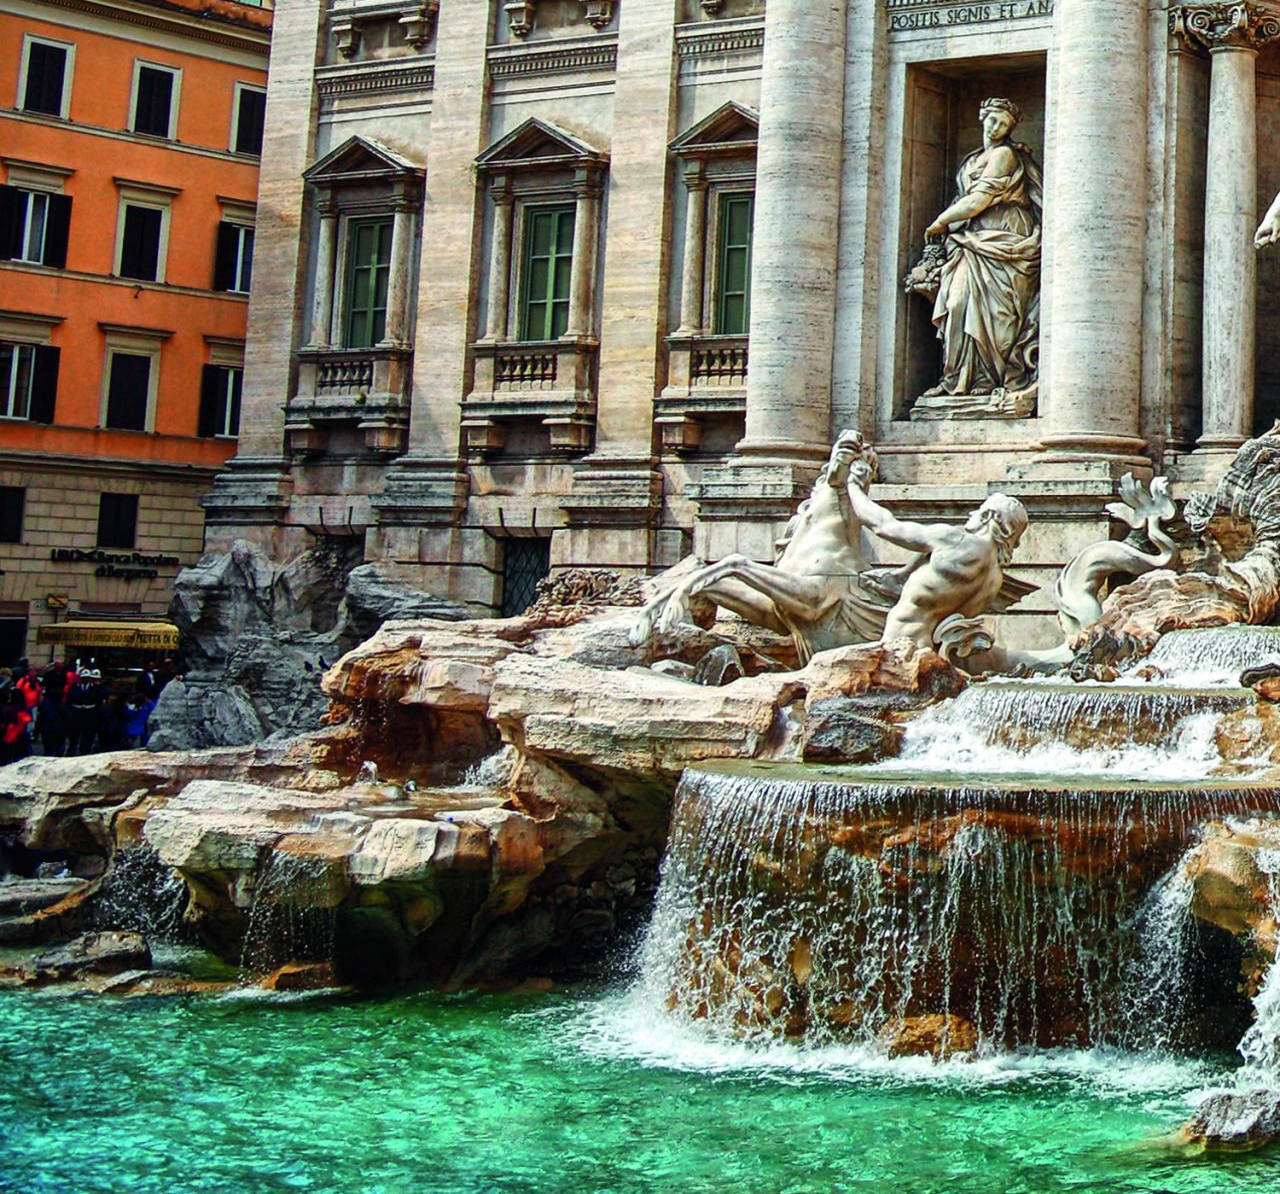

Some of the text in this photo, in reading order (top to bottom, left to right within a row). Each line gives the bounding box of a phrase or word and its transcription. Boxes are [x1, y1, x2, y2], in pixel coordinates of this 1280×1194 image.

[891, 11, 940, 30] POSITIS
[947, 6, 990, 24] SIGNIS
[1000, 3, 1017, 19] ET
